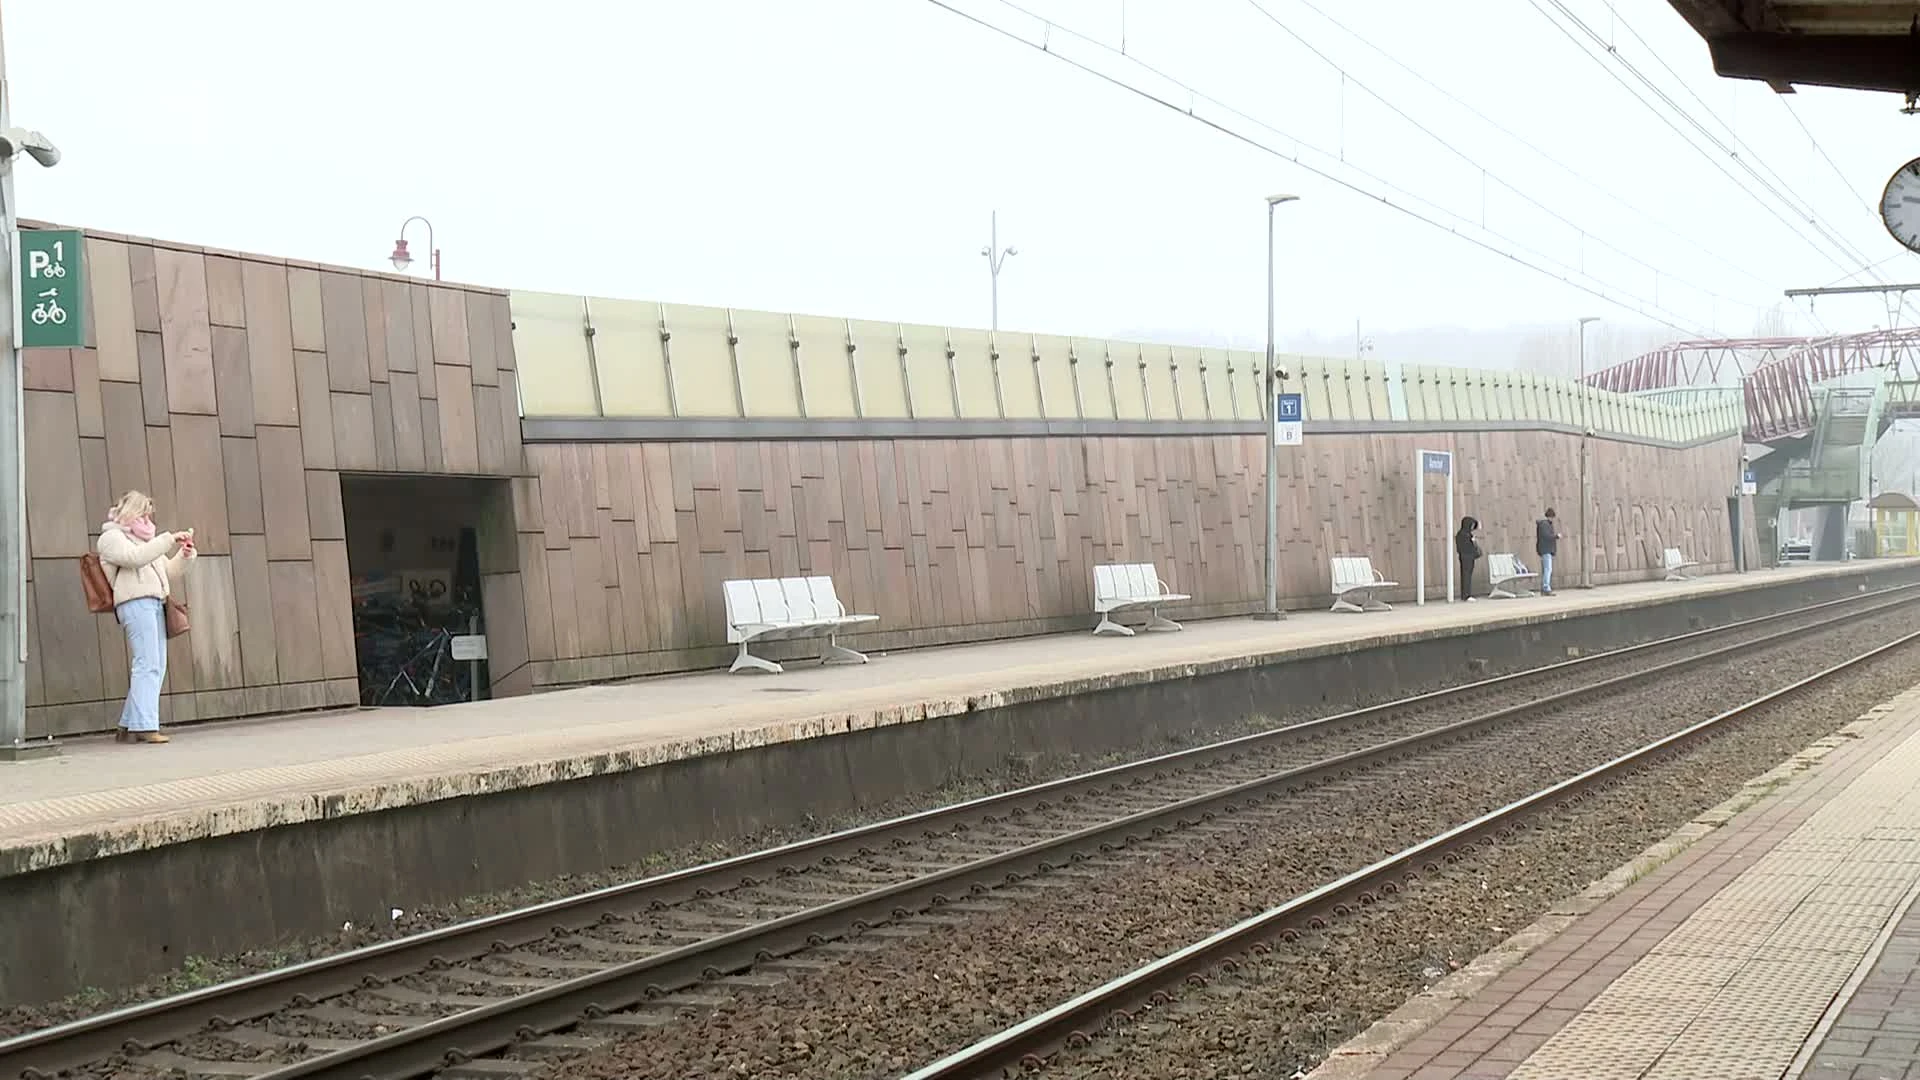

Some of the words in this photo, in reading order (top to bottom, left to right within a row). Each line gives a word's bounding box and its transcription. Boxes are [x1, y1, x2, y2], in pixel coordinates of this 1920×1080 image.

[29, 250, 50, 278] P
[53, 240, 63, 261] 1
[1286, 404, 1292, 415] 1
[1591, 502, 1723, 572] AARSCHOT
